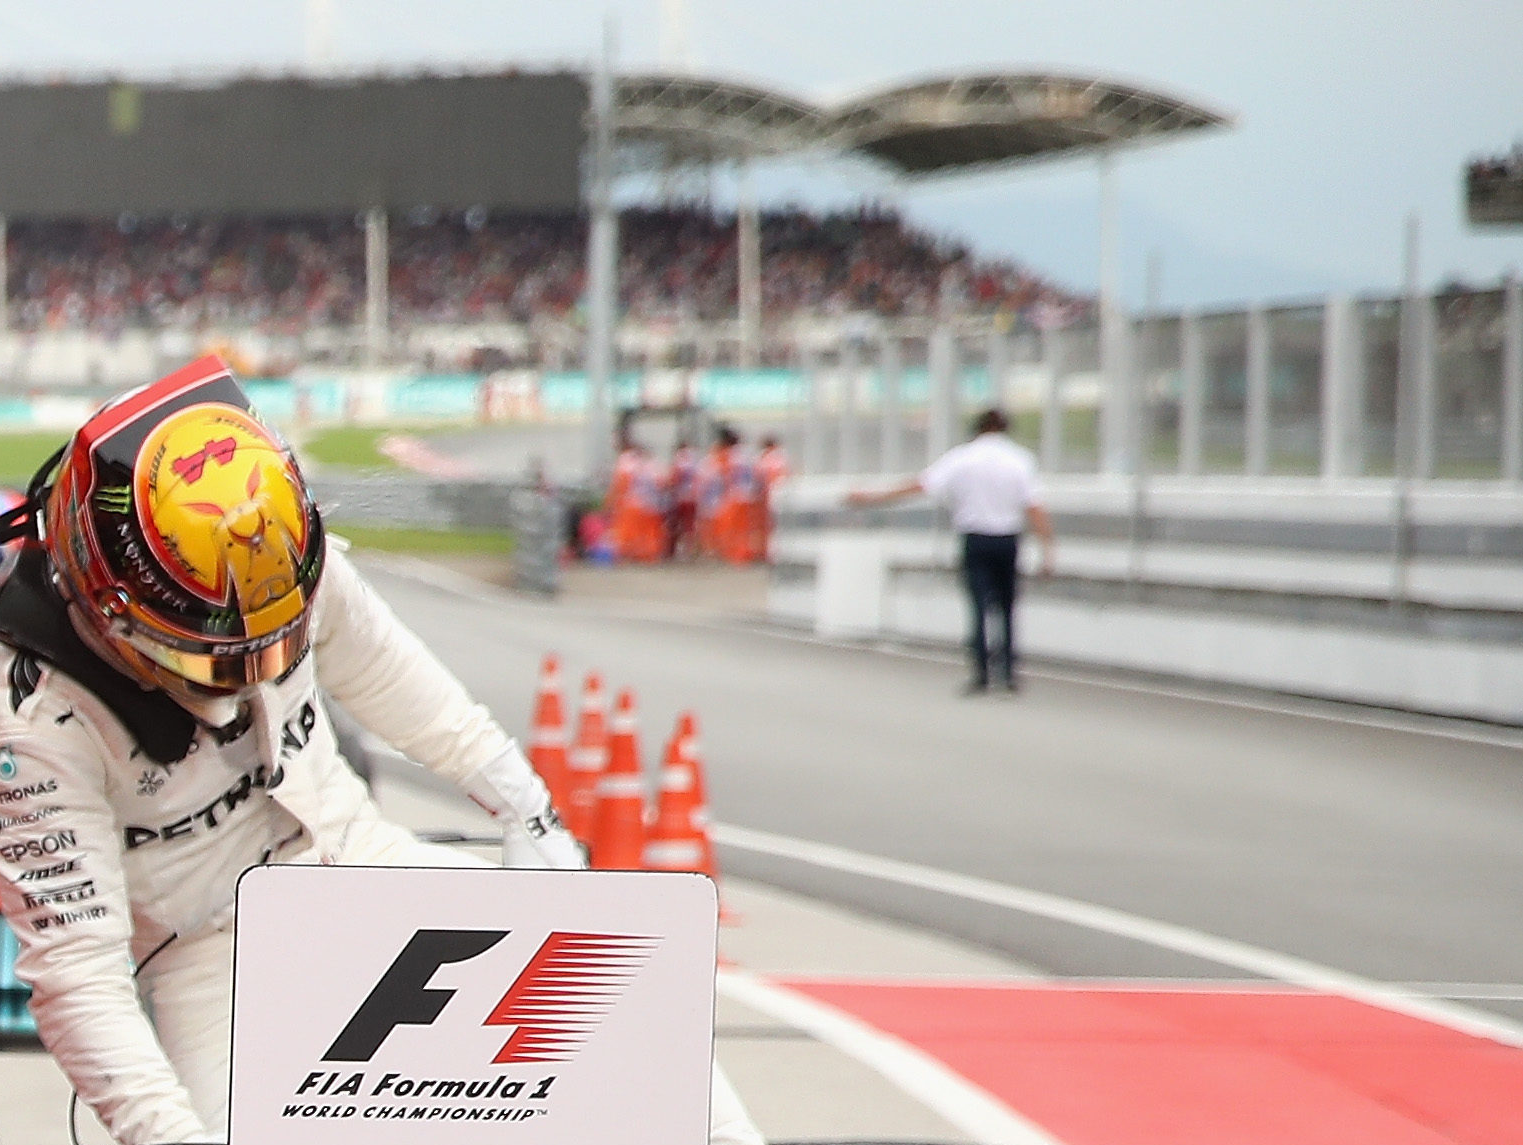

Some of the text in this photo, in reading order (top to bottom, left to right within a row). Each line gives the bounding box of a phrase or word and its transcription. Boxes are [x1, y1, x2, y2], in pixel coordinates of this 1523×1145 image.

[0, 829, 77, 863] EPSON
[321, 929, 665, 1064] F1
[295, 1071, 558, 1100] FIA Formula 1
[281, 1105, 356, 1120] WORLD
